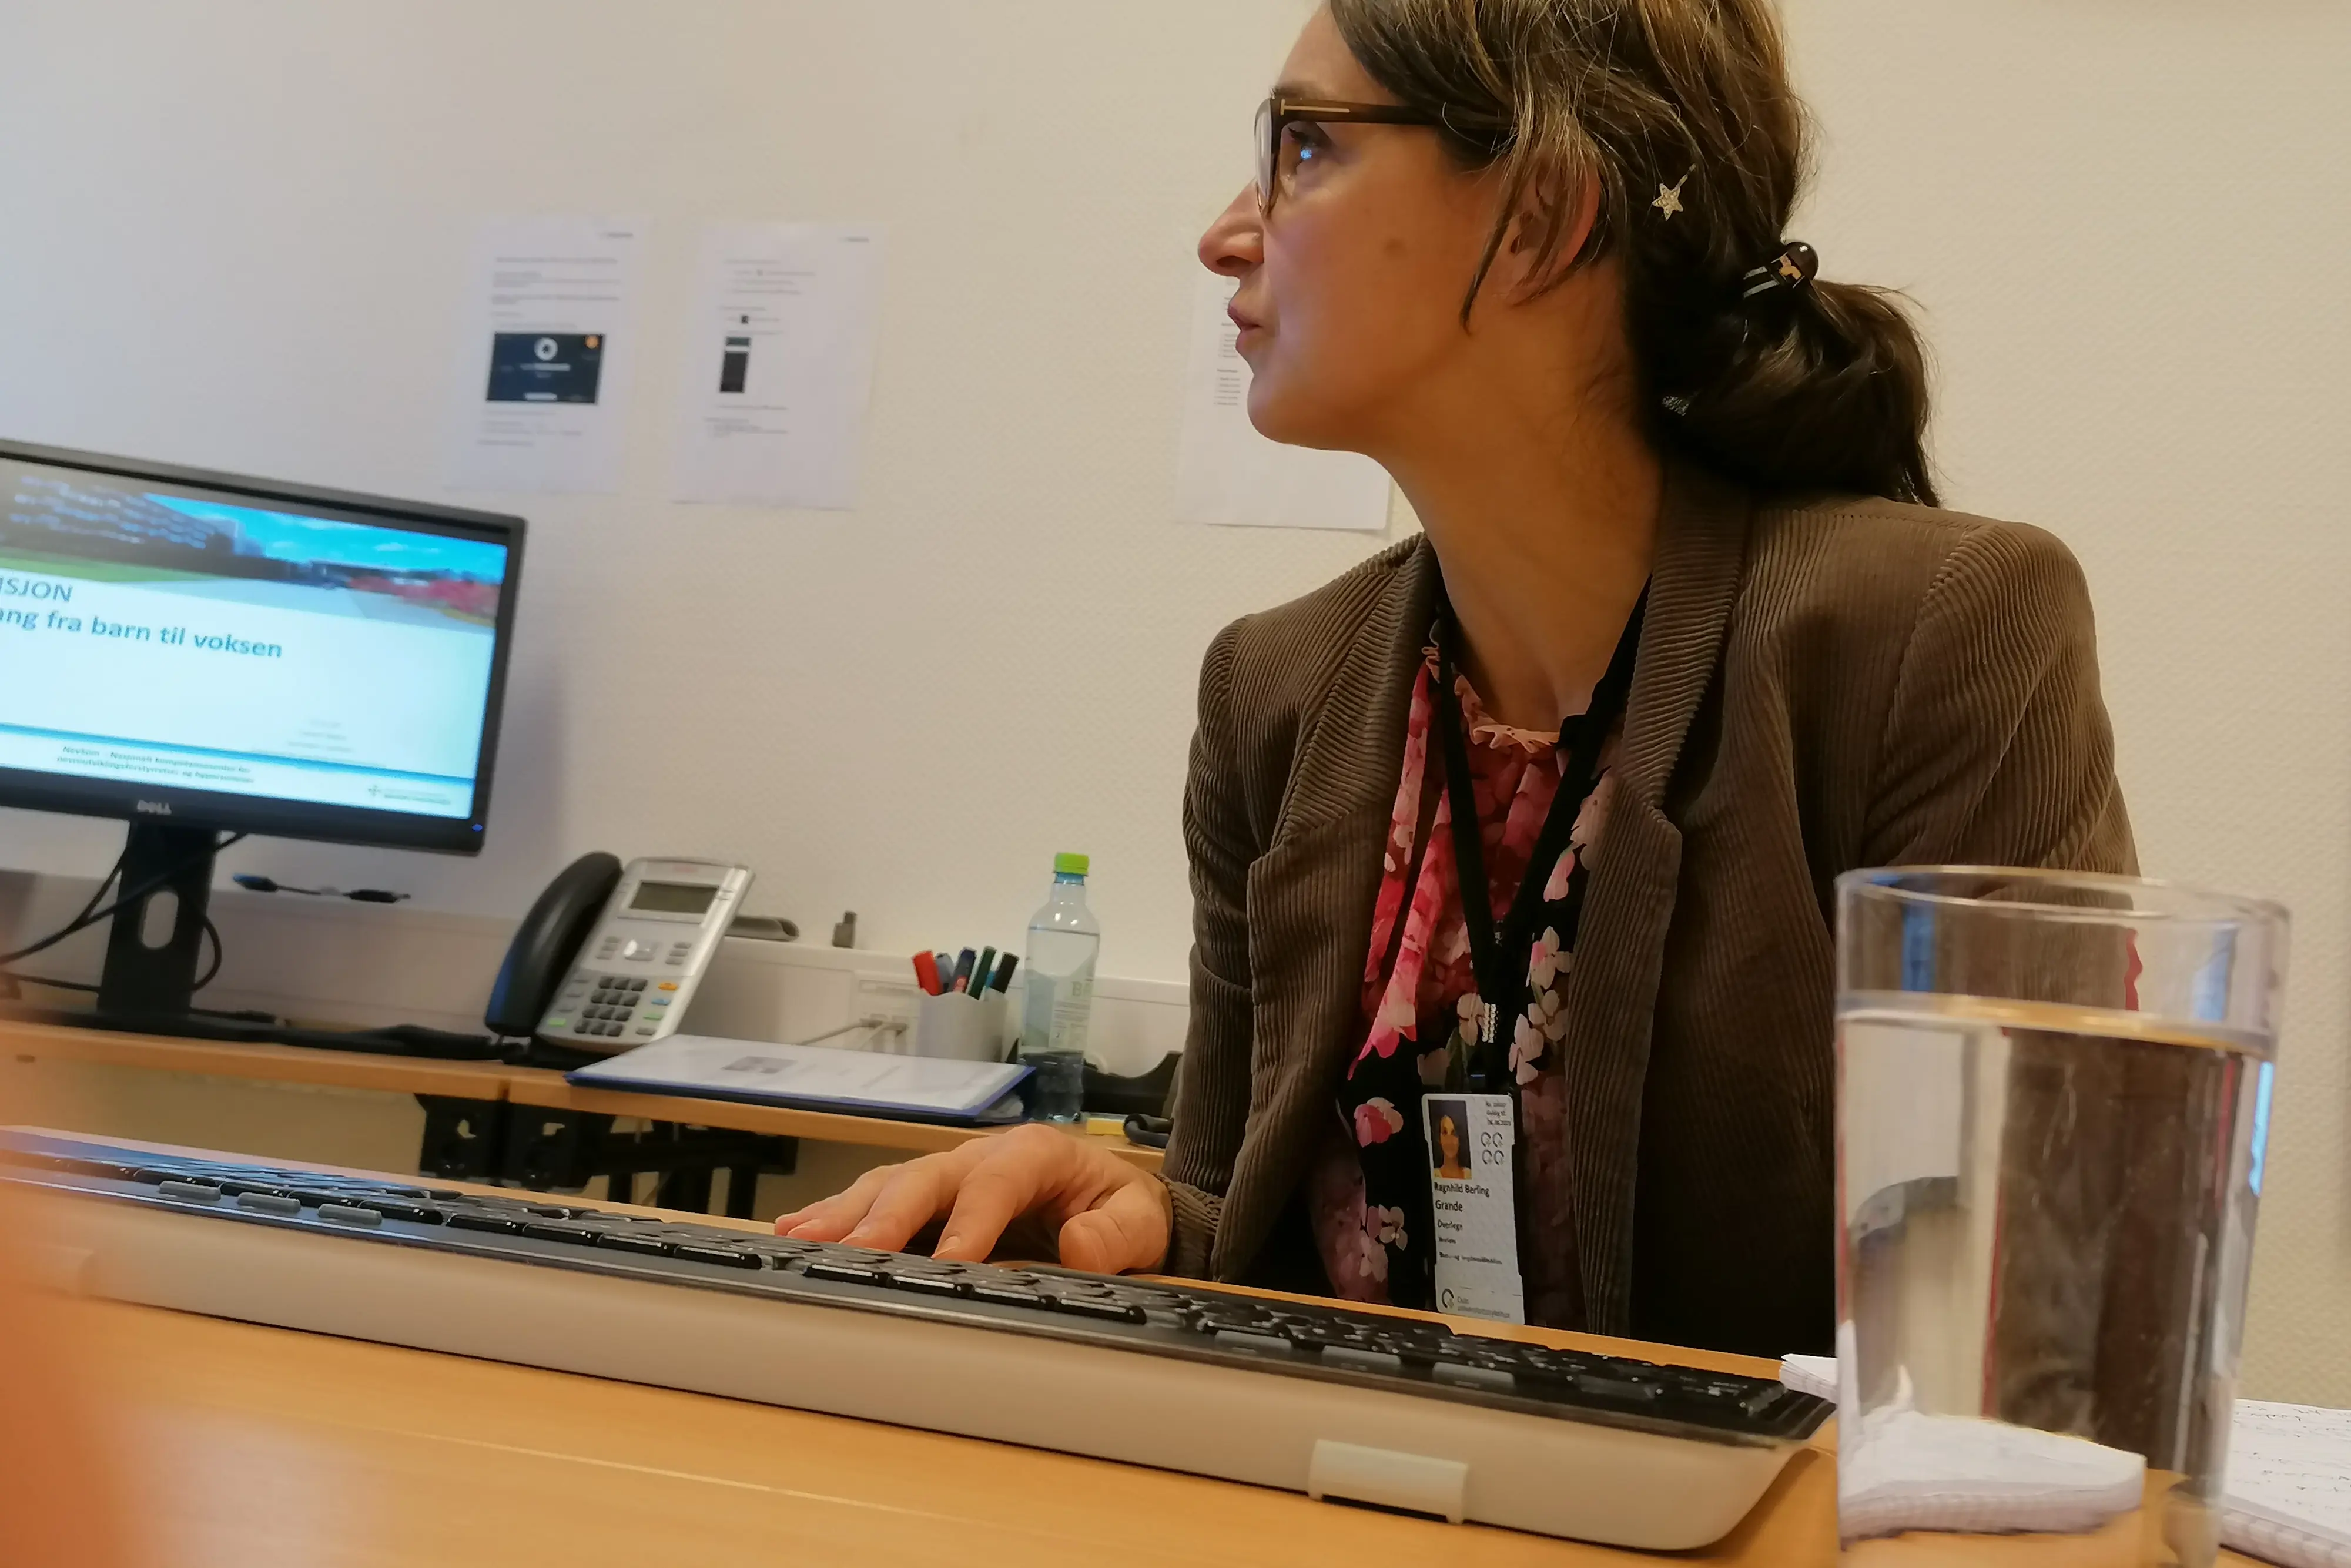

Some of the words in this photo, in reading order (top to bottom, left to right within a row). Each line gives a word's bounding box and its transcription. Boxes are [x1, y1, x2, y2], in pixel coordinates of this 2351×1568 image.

[48, 610, 82, 632] fra
[91, 616, 151, 641] barn
[160, 626, 186, 645] til
[194, 634, 282, 658] voksen
[1435, 1200, 1463, 1212] Grande
